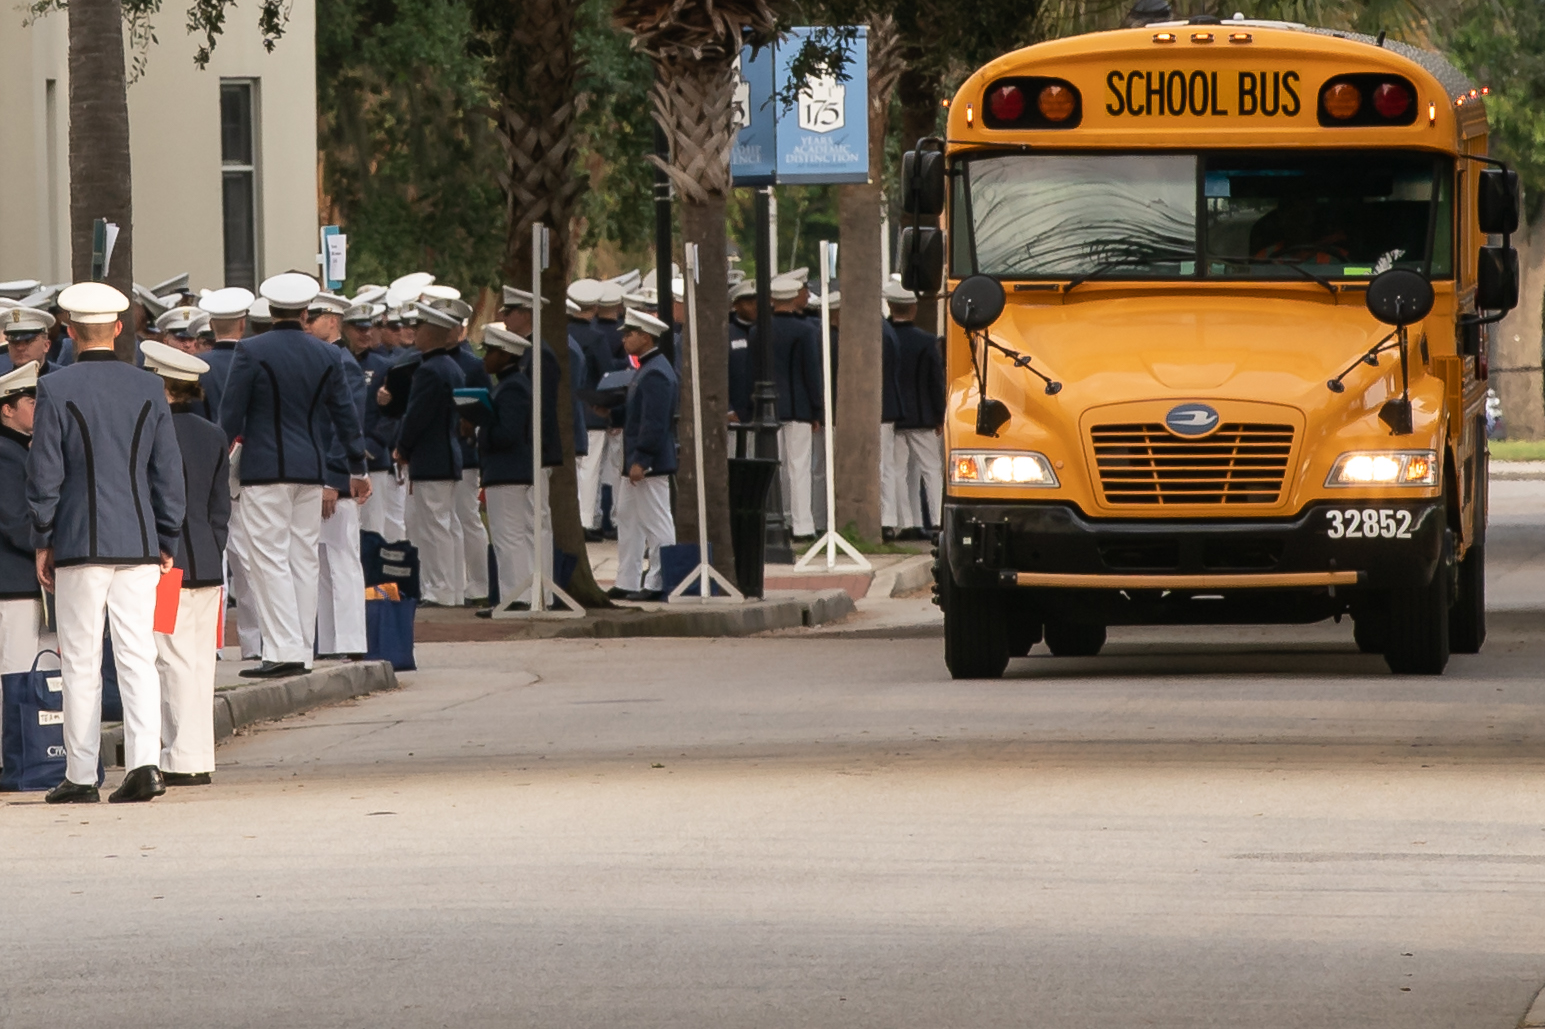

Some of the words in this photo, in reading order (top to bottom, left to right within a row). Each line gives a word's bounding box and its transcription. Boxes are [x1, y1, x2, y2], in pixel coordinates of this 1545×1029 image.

[1106, 70, 1228, 117] SCHOOL
[1238, 70, 1301, 117] BUS
[805, 100, 839, 126] 175
[801, 135, 834, 145] YEARS
[785, 153, 859, 163] DISTINCTION
[793, 144, 851, 155] ACADEMIC
[1326, 508, 1412, 539] 32852
